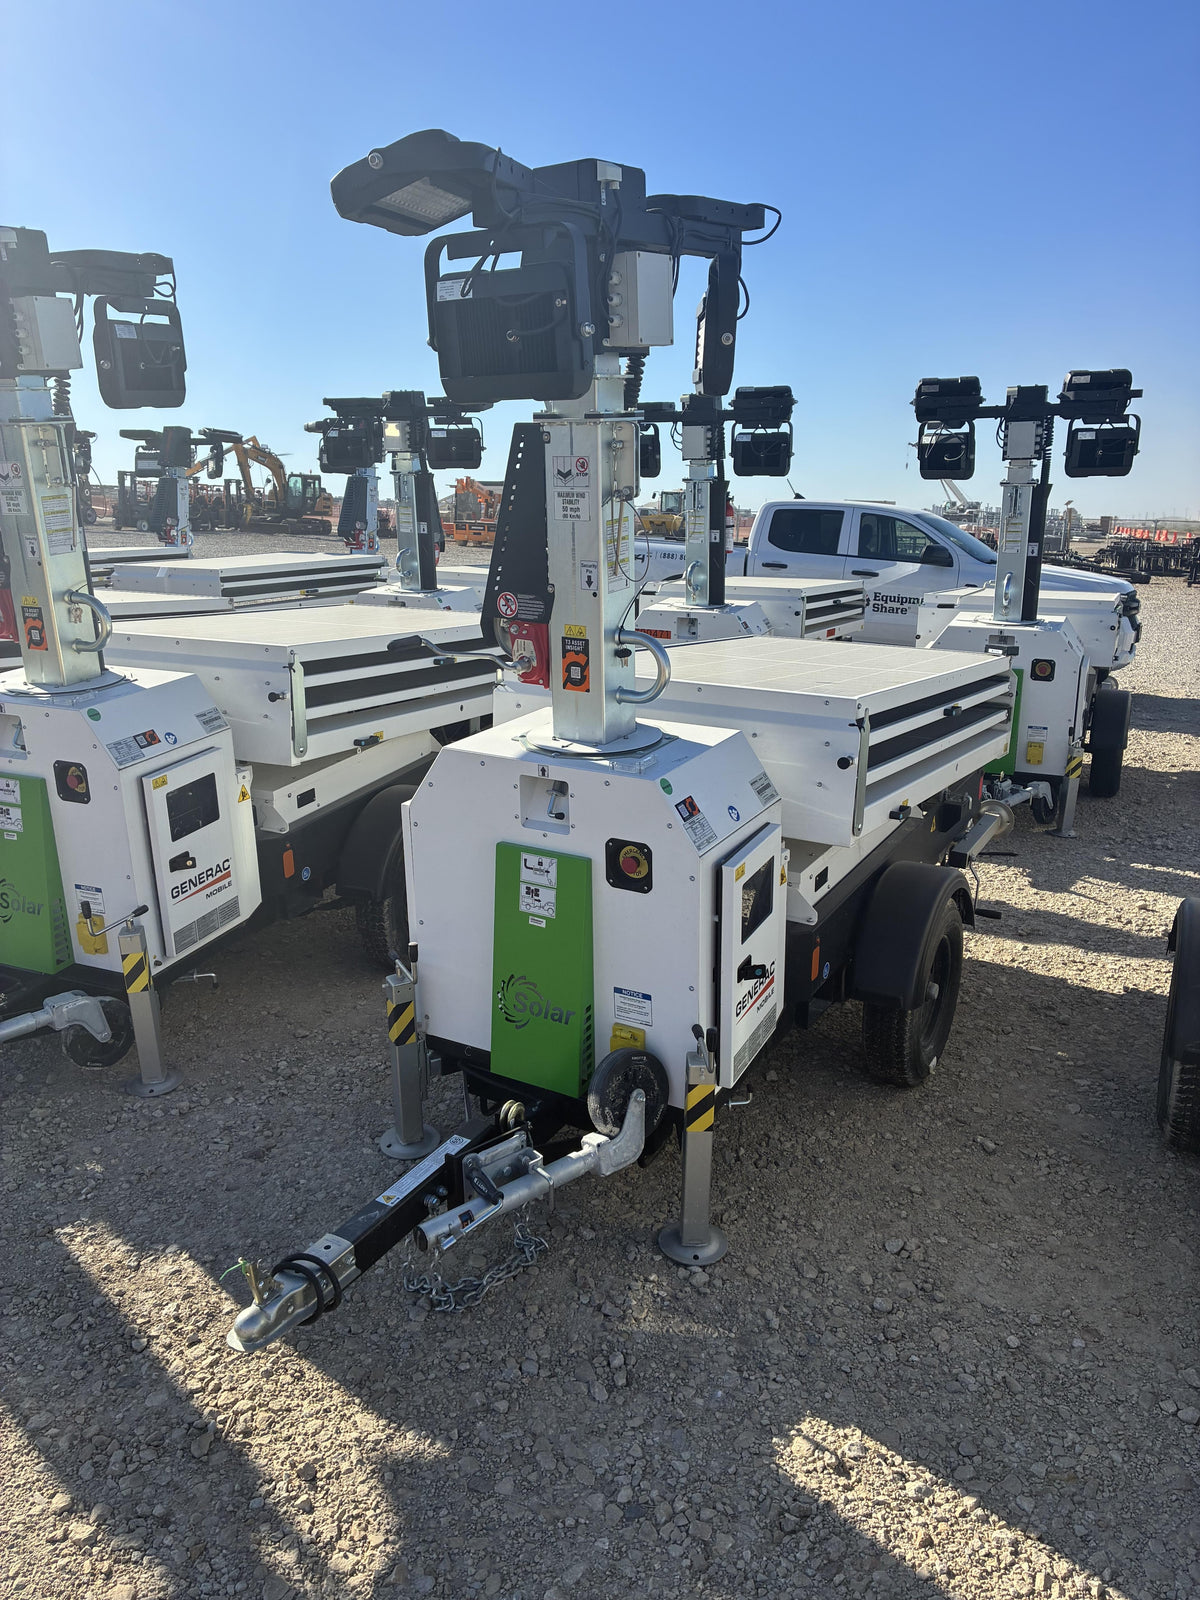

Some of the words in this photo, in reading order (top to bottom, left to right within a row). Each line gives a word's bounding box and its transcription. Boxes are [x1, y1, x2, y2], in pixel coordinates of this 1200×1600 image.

[562, 505, 569, 513] 50
[872, 603, 908, 615] Share
[171, 858, 231, 900] GENERAC
[205, 880, 232, 900] MOBILE
[0, 892, 44, 916] Solar
[621, 989, 643, 999] NOTICE
[756, 986, 775, 1014] MOBILE
[514, 991, 577, 1026] Solar
